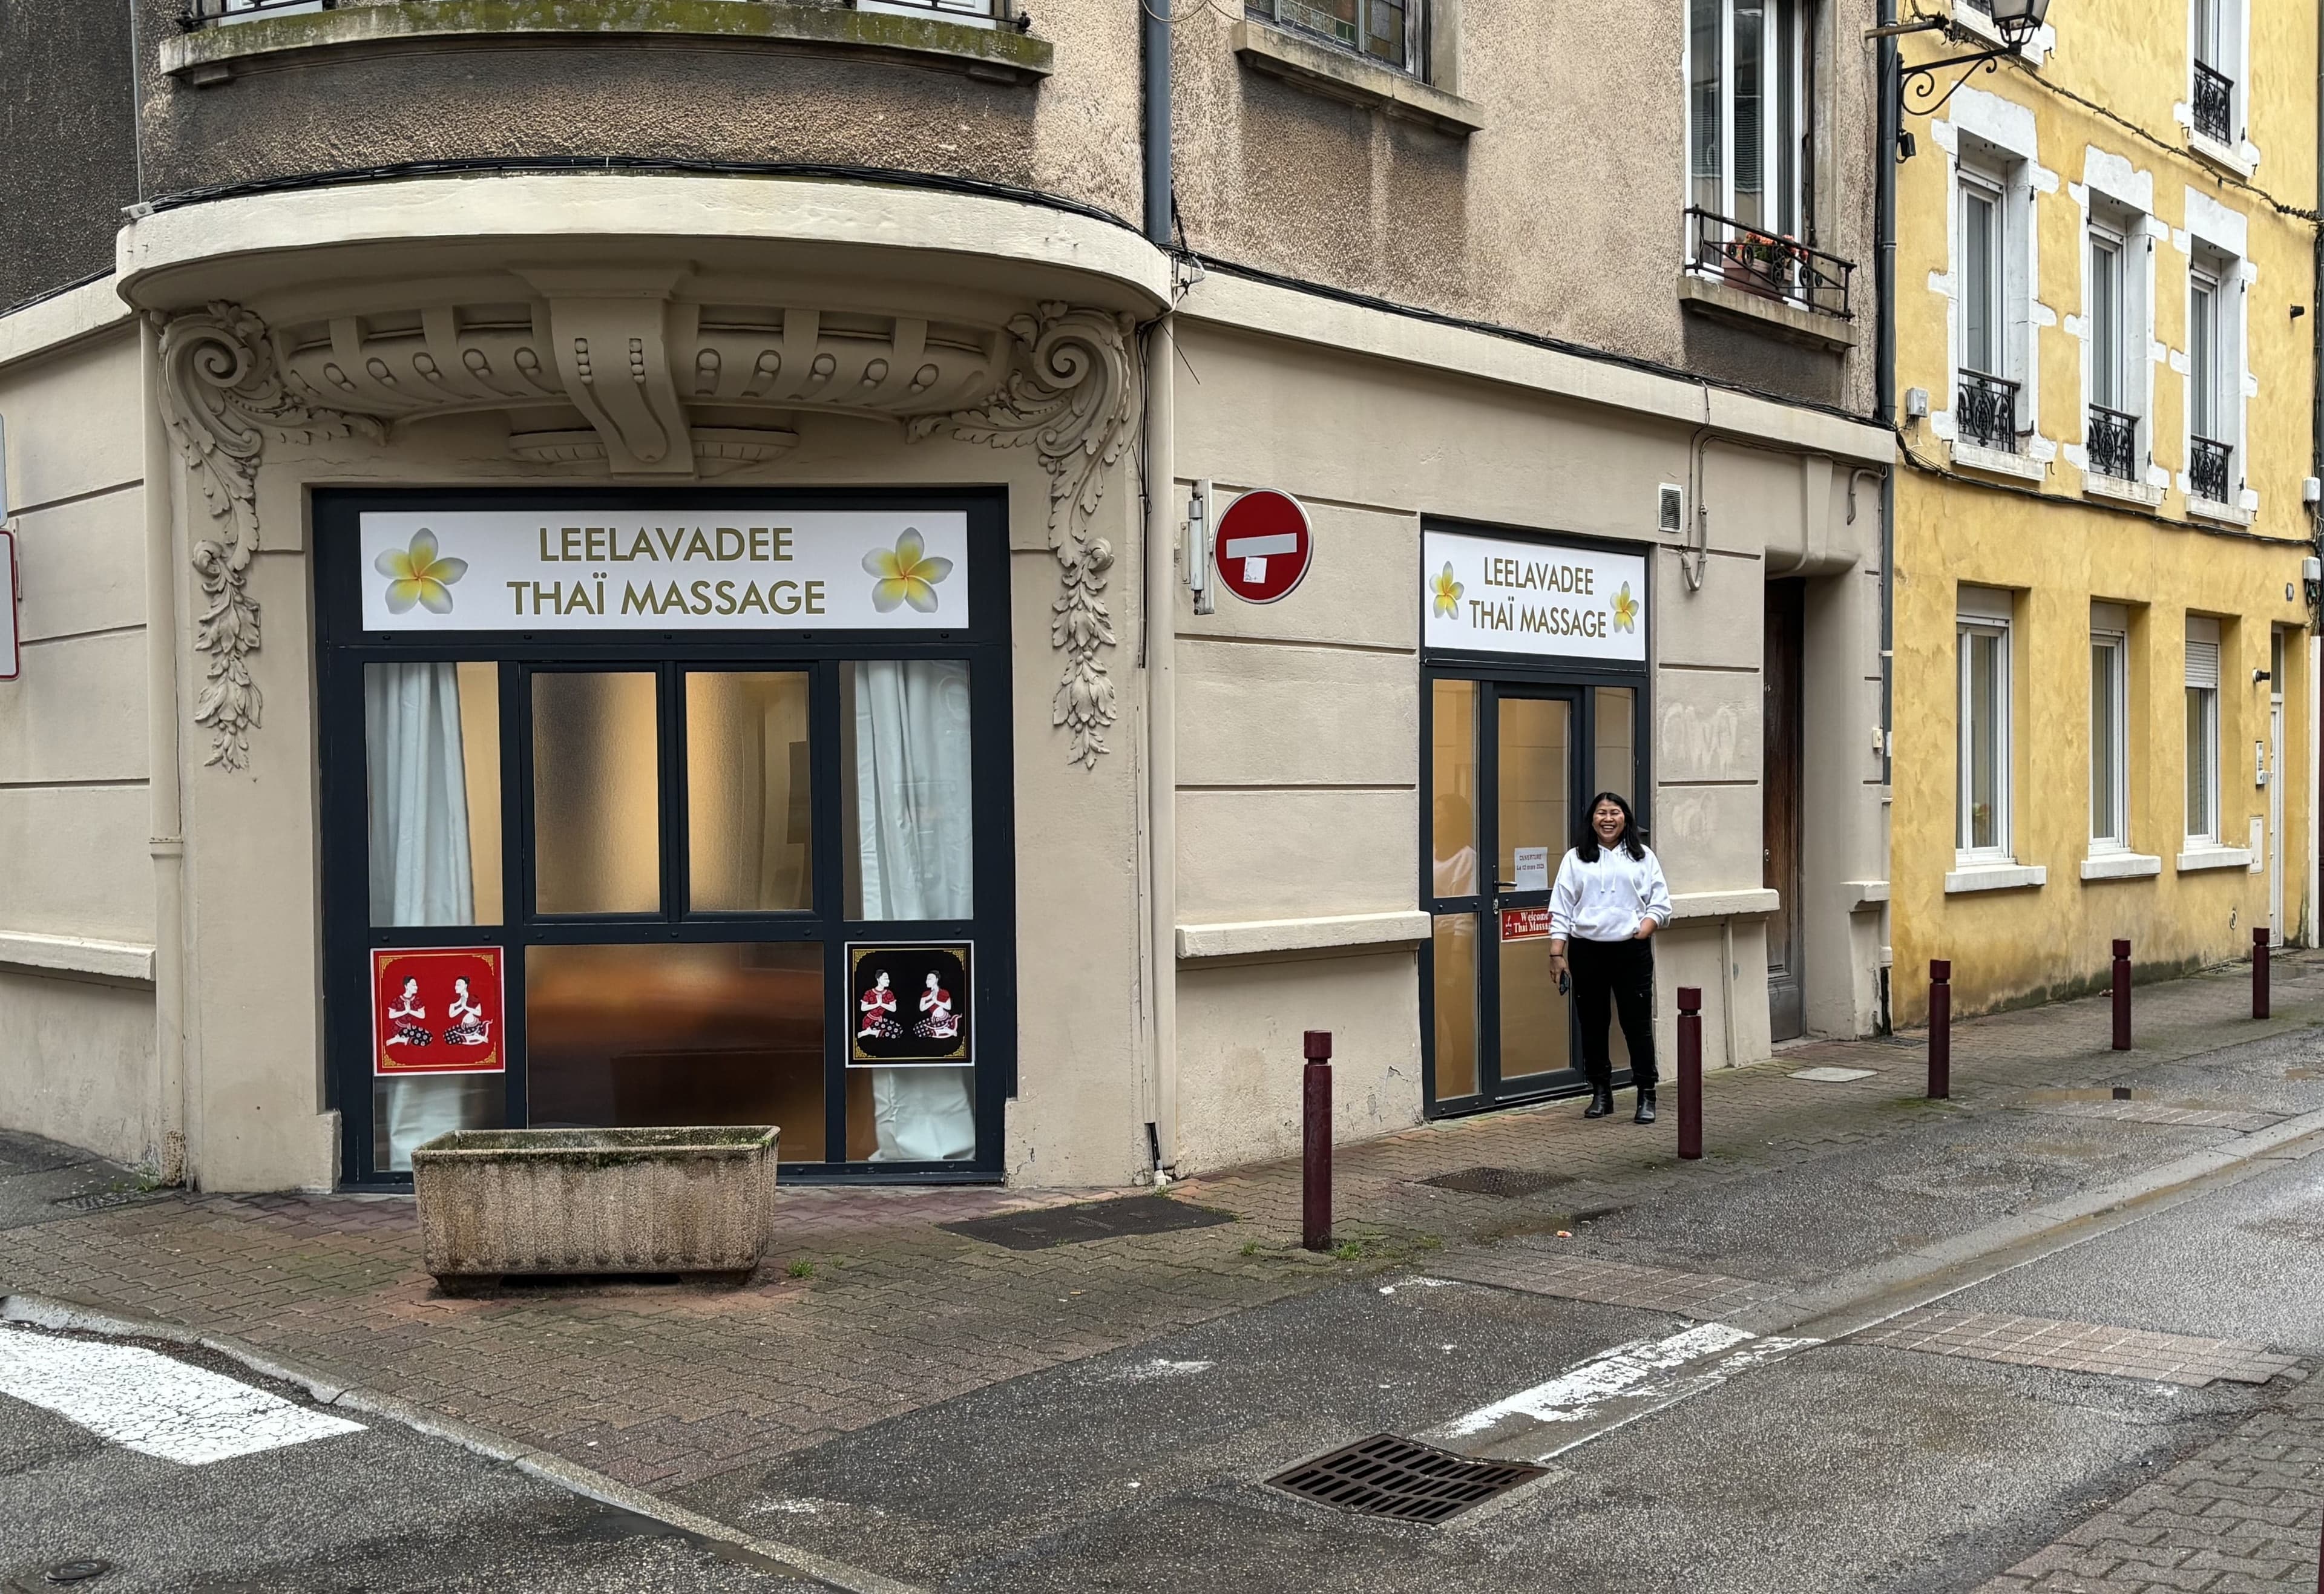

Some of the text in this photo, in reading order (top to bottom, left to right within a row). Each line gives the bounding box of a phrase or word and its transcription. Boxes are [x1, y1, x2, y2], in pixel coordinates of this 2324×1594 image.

[540, 526, 793, 562] LEELAVADEE
[507, 572, 824, 616] THAÏ MASSAGE
[1484, 557, 1594, 595] LEELAVADEE
[1469, 595, 1606, 638] THAÏ MASSAGE
[1514, 920, 1551, 933] Thai Massa
